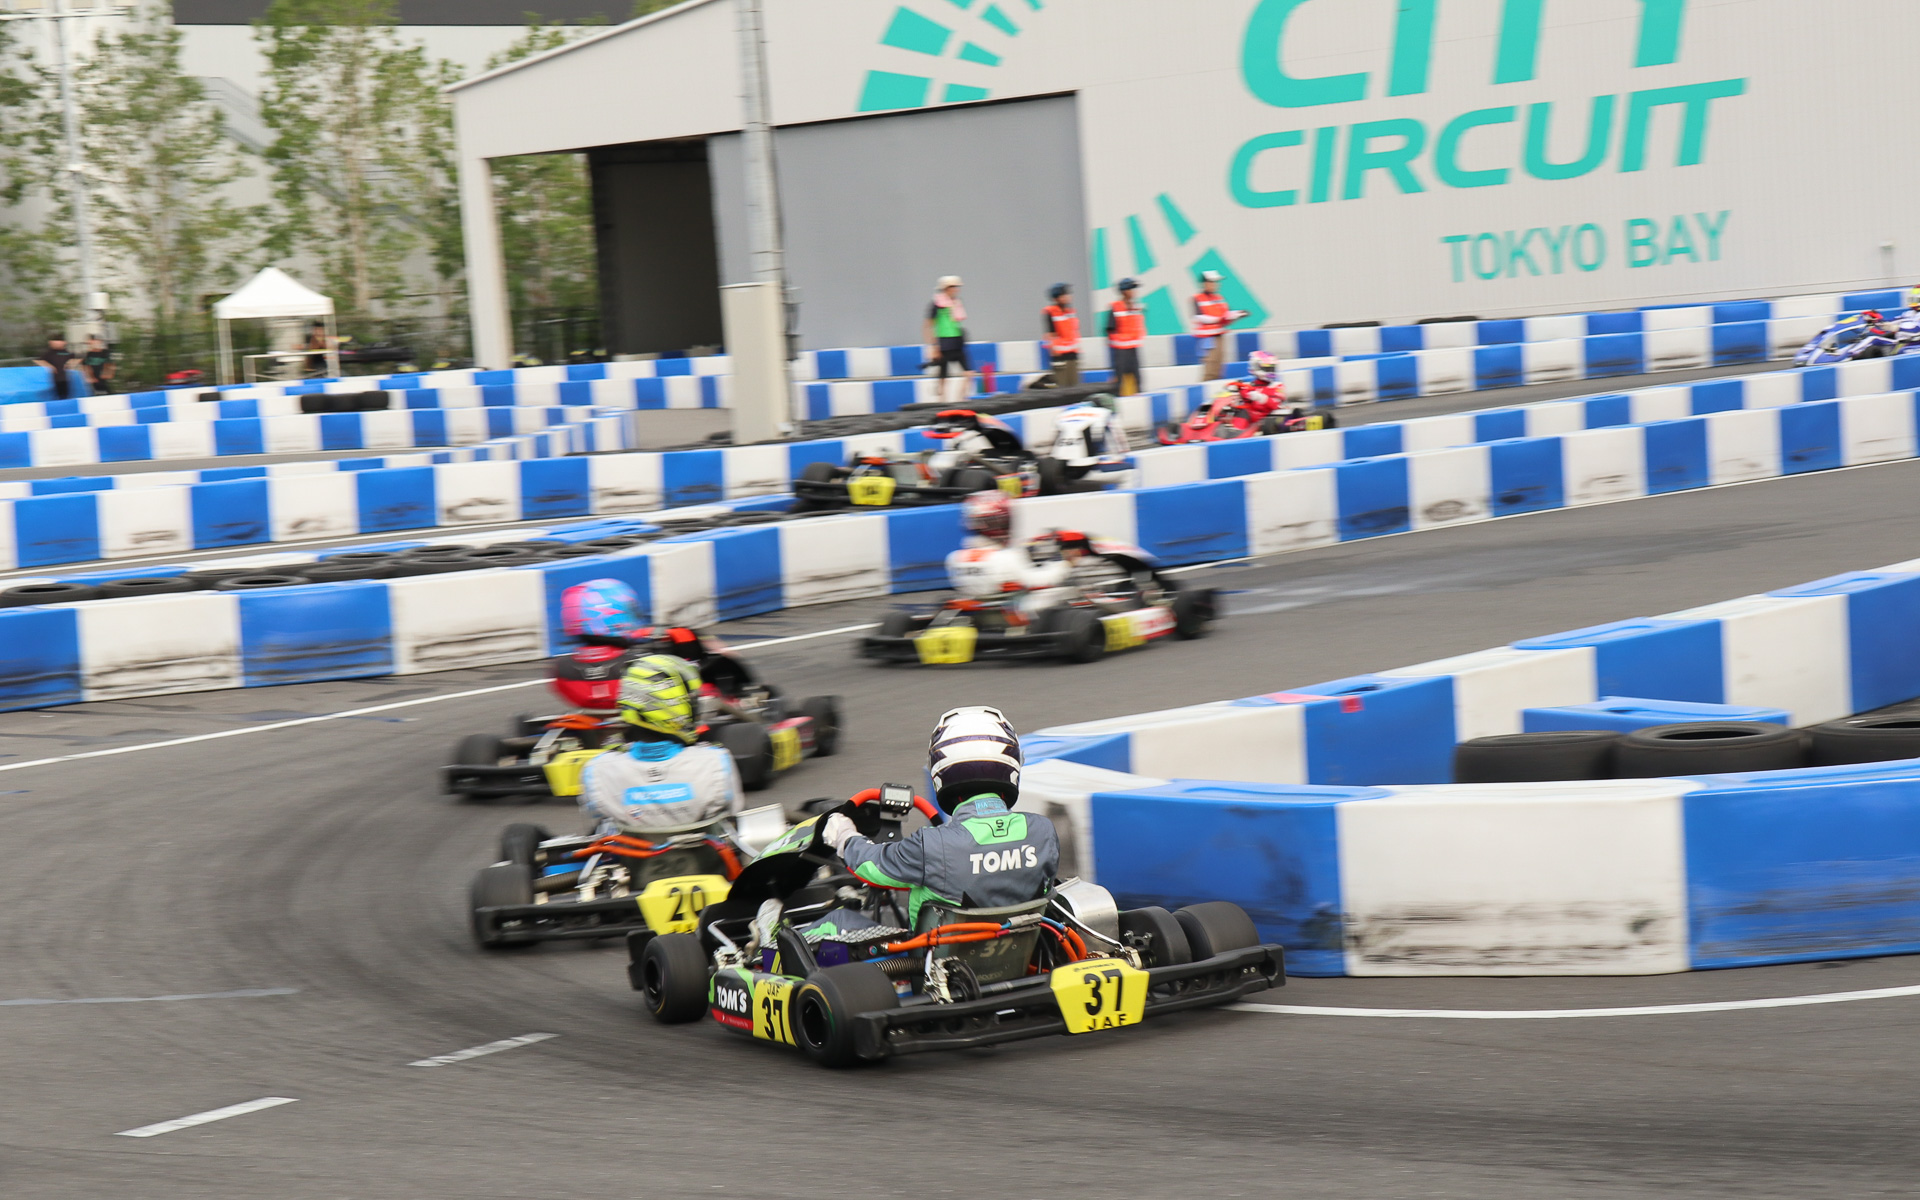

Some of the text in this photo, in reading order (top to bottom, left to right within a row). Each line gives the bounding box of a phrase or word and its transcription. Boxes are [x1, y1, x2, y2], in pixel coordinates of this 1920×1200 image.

[1228, 77, 1747, 209] CIRCUIT
[1441, 210, 1732, 283] TOKYO BAY
[969, 844, 1038, 875] TOM'S
[668, 887, 706, 921] 20
[980, 937, 1014, 958] 37
[717, 985, 748, 1014] TOM'S
[1084, 968, 1123, 1016] 37
[762, 997, 788, 1043] 37
[1087, 1014, 1127, 1031] JAF
